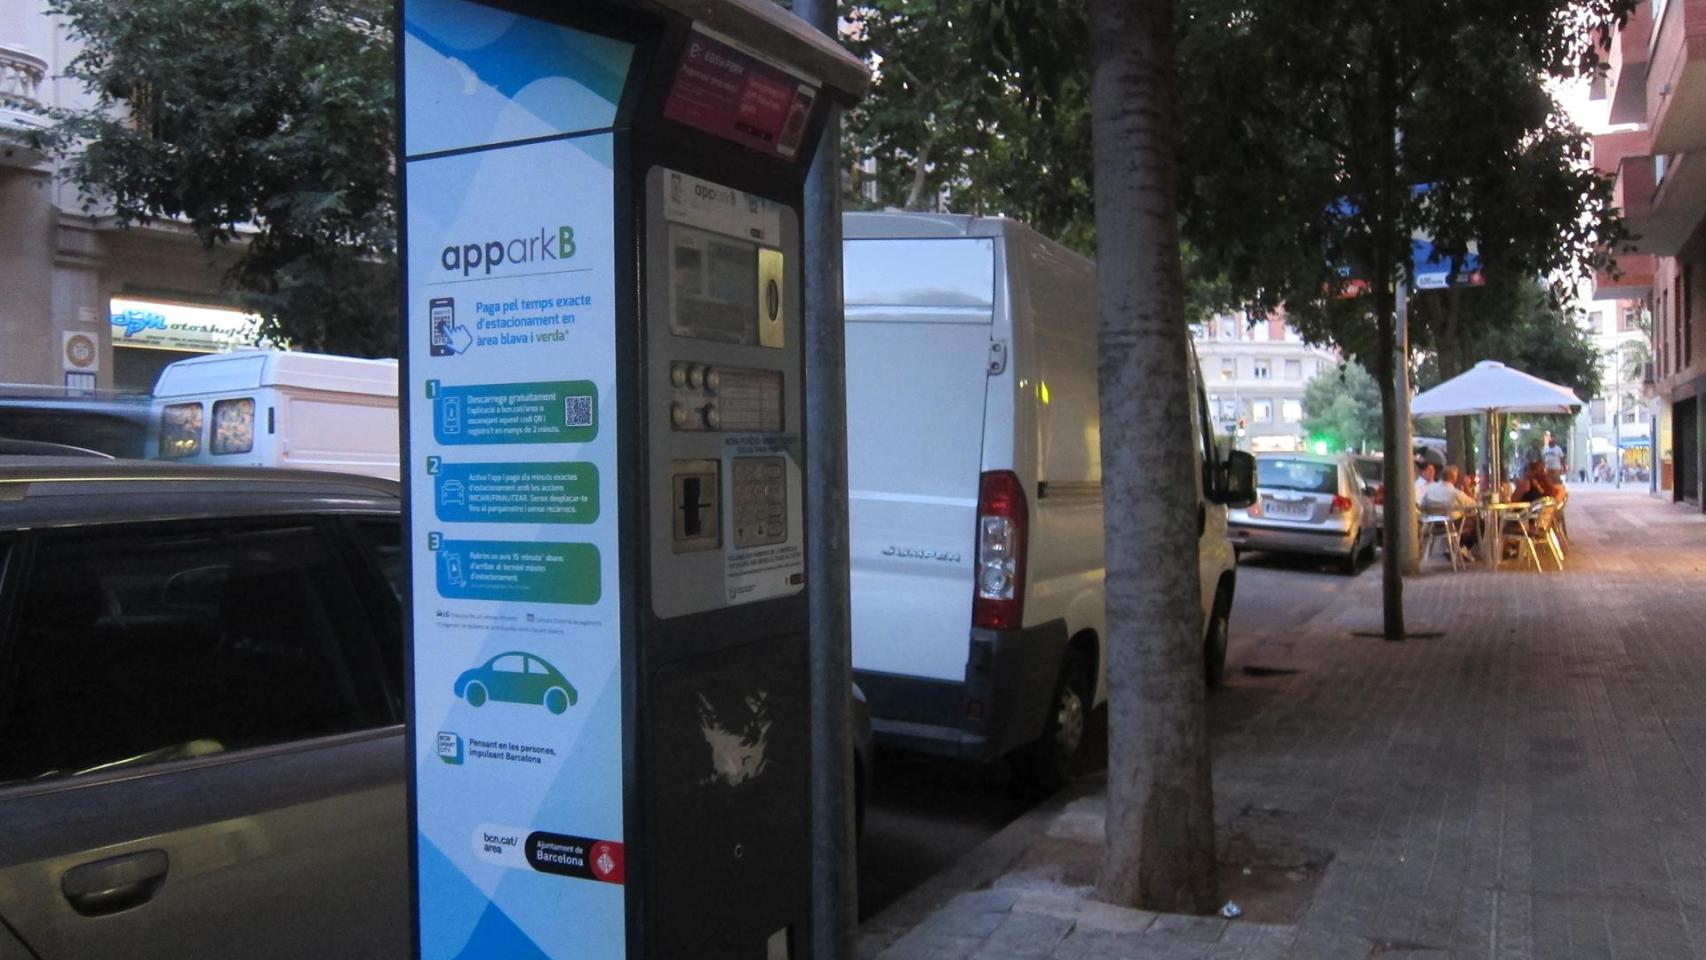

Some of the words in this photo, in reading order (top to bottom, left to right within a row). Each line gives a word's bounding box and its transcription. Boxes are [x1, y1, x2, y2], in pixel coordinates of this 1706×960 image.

[442, 226, 576, 276] apparkB
[476, 302, 500, 317] Paga
[503, 300, 518, 314] pel
[521, 298, 554, 313] temps
[556, 294, 591, 308] exacte
[476, 312, 560, 330] d'estacionament
[562, 314, 574, 324] en
[500, 330, 528, 344] blava
[530, 330, 534, 342] i
[430, 382, 436, 396] 1
[429, 458, 438, 473] 2
[431, 534, 440, 548] 3
[469, 738, 497, 748] Pensant
[509, 742, 519, 750] les
[520, 744, 557, 756] persones,
[469, 748, 504, 760] impulsant
[505, 752, 542, 764] Barcelona
[484, 832, 518, 846] bcn.cat/
[484, 844, 502, 854] area
[536, 840, 573, 853] Ajuntament
[574, 846, 584, 854] de
[536, 850, 584, 866] Barcelona
